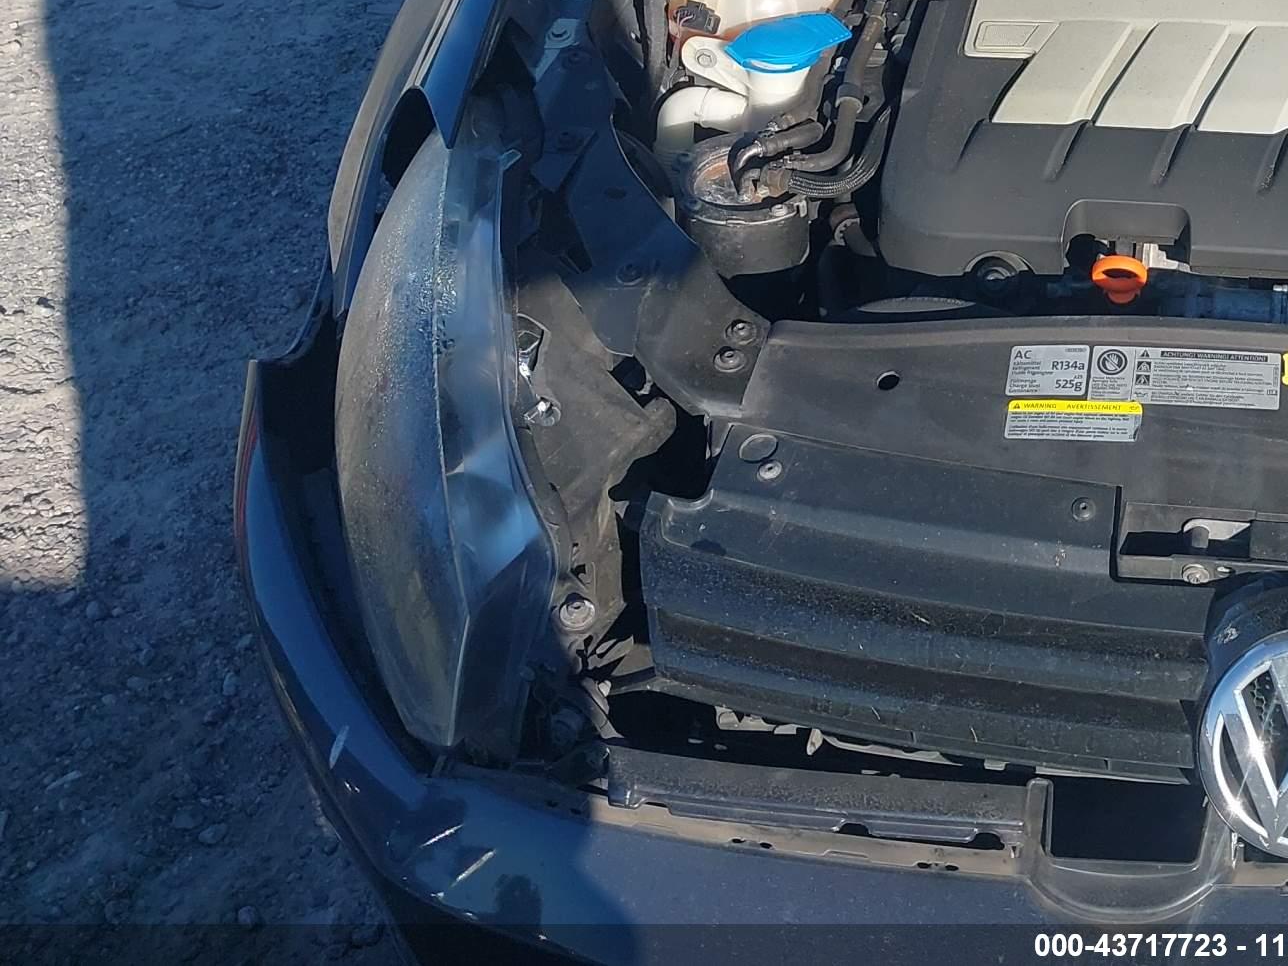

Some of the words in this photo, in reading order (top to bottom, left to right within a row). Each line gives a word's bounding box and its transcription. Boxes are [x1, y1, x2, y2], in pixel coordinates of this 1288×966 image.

[1014, 350, 1032, 360] AC
[1052, 360, 1085, 371] R134a
[1055, 379, 1083, 392] 525g
[1066, 403, 1121, 411] AVERTISSEMENT
